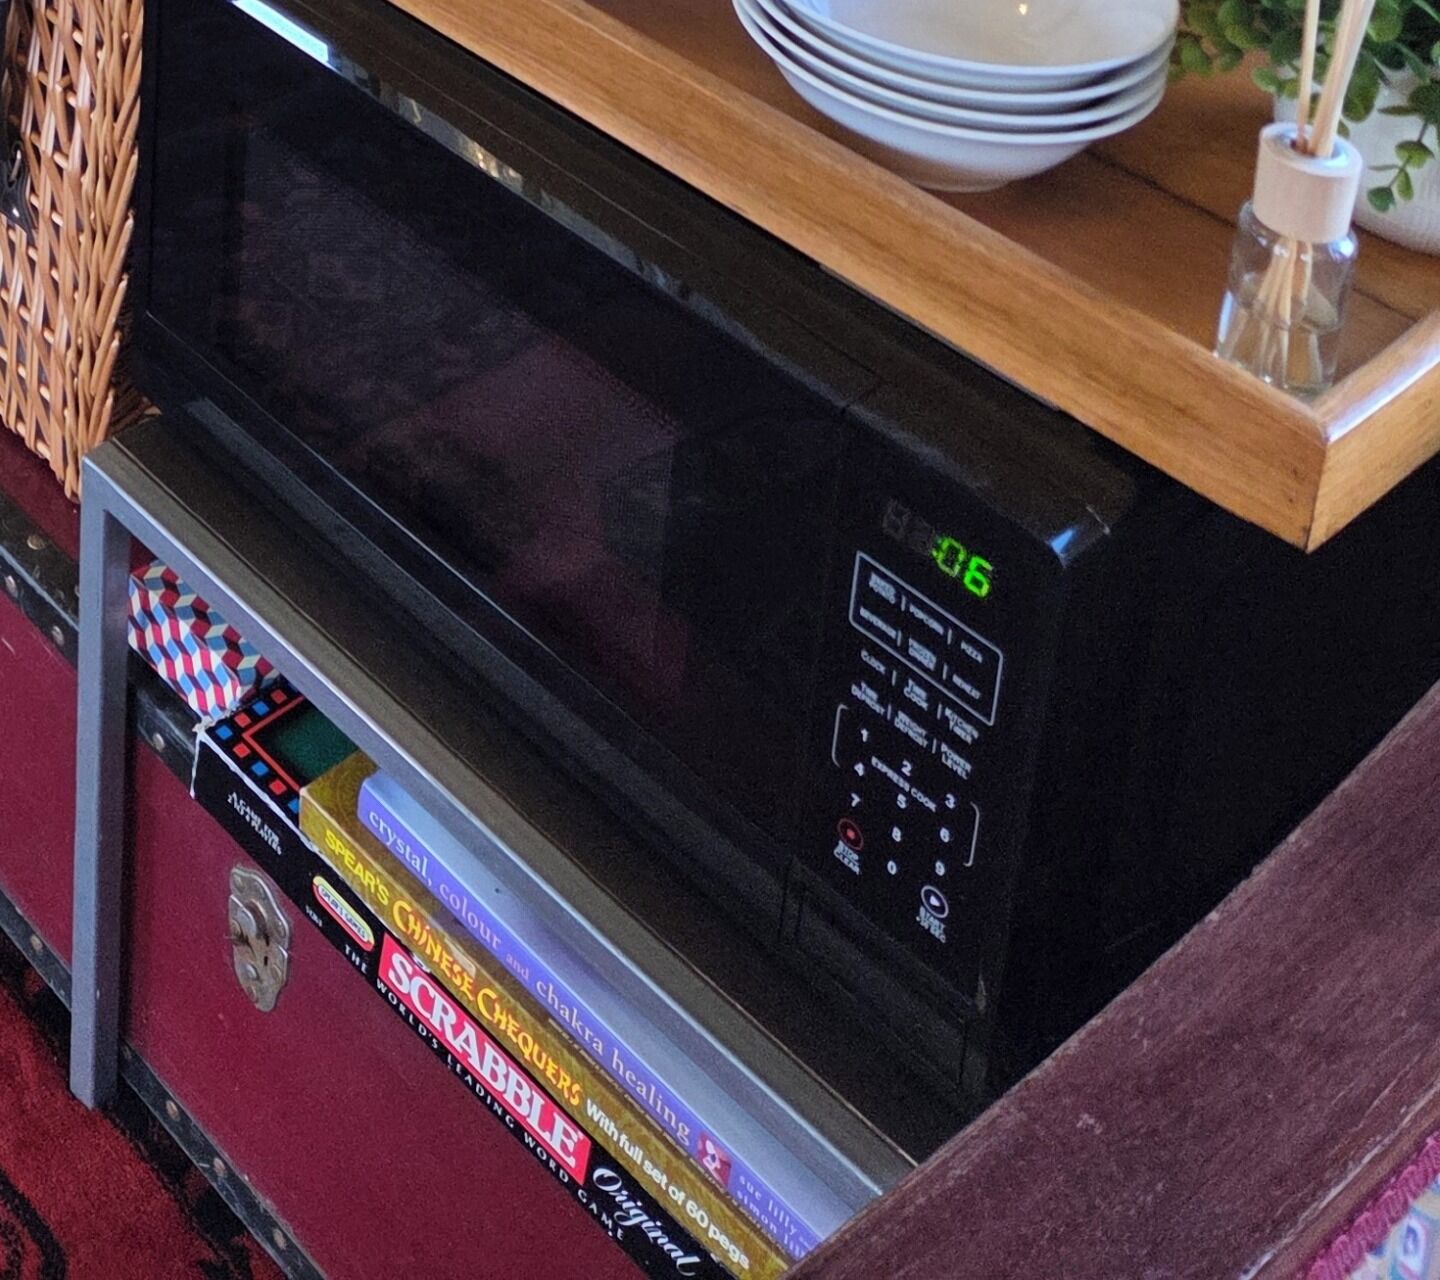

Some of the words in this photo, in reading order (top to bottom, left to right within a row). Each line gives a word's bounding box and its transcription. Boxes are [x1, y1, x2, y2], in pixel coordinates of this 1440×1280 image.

[861, 649, 886, 674] CLOCK
[854, 762, 865, 776] 4
[902, 759, 912, 776] 2
[851, 793, 860, 807] 7
[896, 793, 907, 809] 5
[910, 787, 937, 813] COOK
[945, 793, 955, 809] 3
[892, 826, 902, 842] 8
[940, 827, 950, 843] 6
[887, 860, 897, 875] 0
[935, 860, 945, 876] 9
[369, 810, 433, 887] crystal,
[439, 883, 502, 950] colour
[506, 953, 530, 980] and
[536, 980, 603, 1056] chakra
[612, 1049, 691, 1146] healing
[325, 829, 389, 906] SPEAR'S
[477, 988, 583, 1106] CHEQUERS
[586, 1098, 619, 1142] With
[619, 1134, 643, 1166] full
[643, 1160, 668, 1191] set
[668, 1183, 686, 1205] of
[686, 1199, 709, 1228] 60
[708, 1223, 751, 1270] pegs
[344, 944, 368, 974] THE
[376, 980, 440, 1049] WORLD'S
[447, 1054, 514, 1128] LEADING
[523, 1132, 569, 1183] WORD
[577, 1190, 624, 1240] GAME
[388, 952, 581, 1169] SCRABBLE
[592, 1167, 700, 1277] Original
